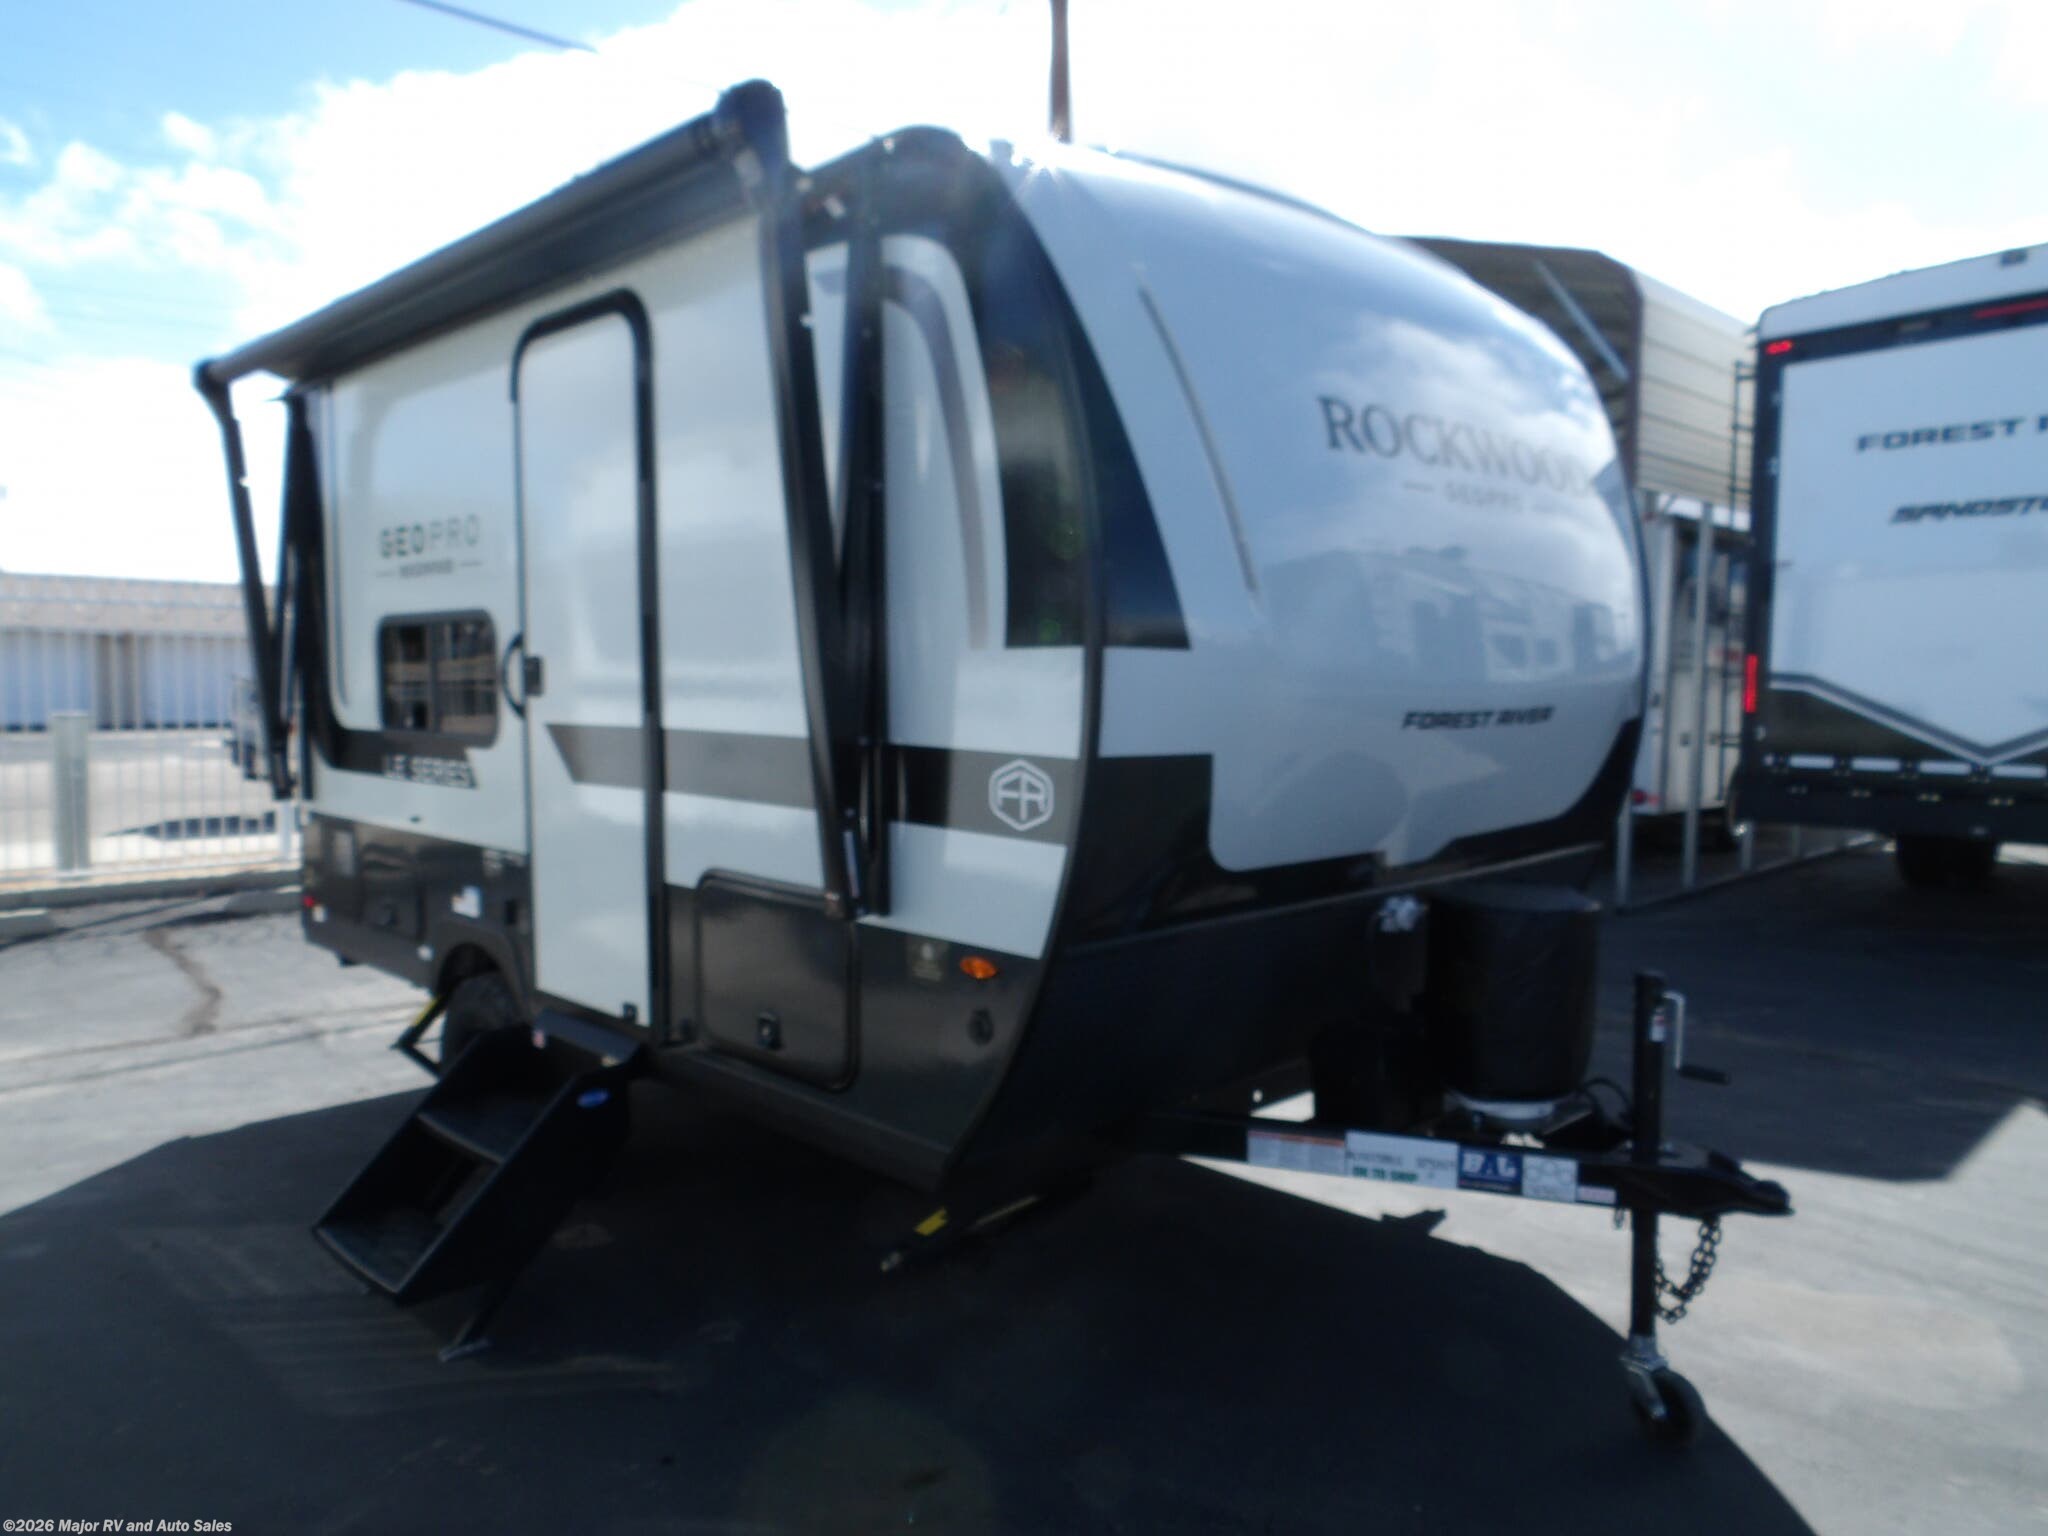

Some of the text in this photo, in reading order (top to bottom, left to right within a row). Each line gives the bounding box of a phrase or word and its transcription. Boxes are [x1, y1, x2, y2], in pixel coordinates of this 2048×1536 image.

[1857, 415, 2025, 453] FOREST
[1401, 704, 1557, 731] FOREST RIVER
